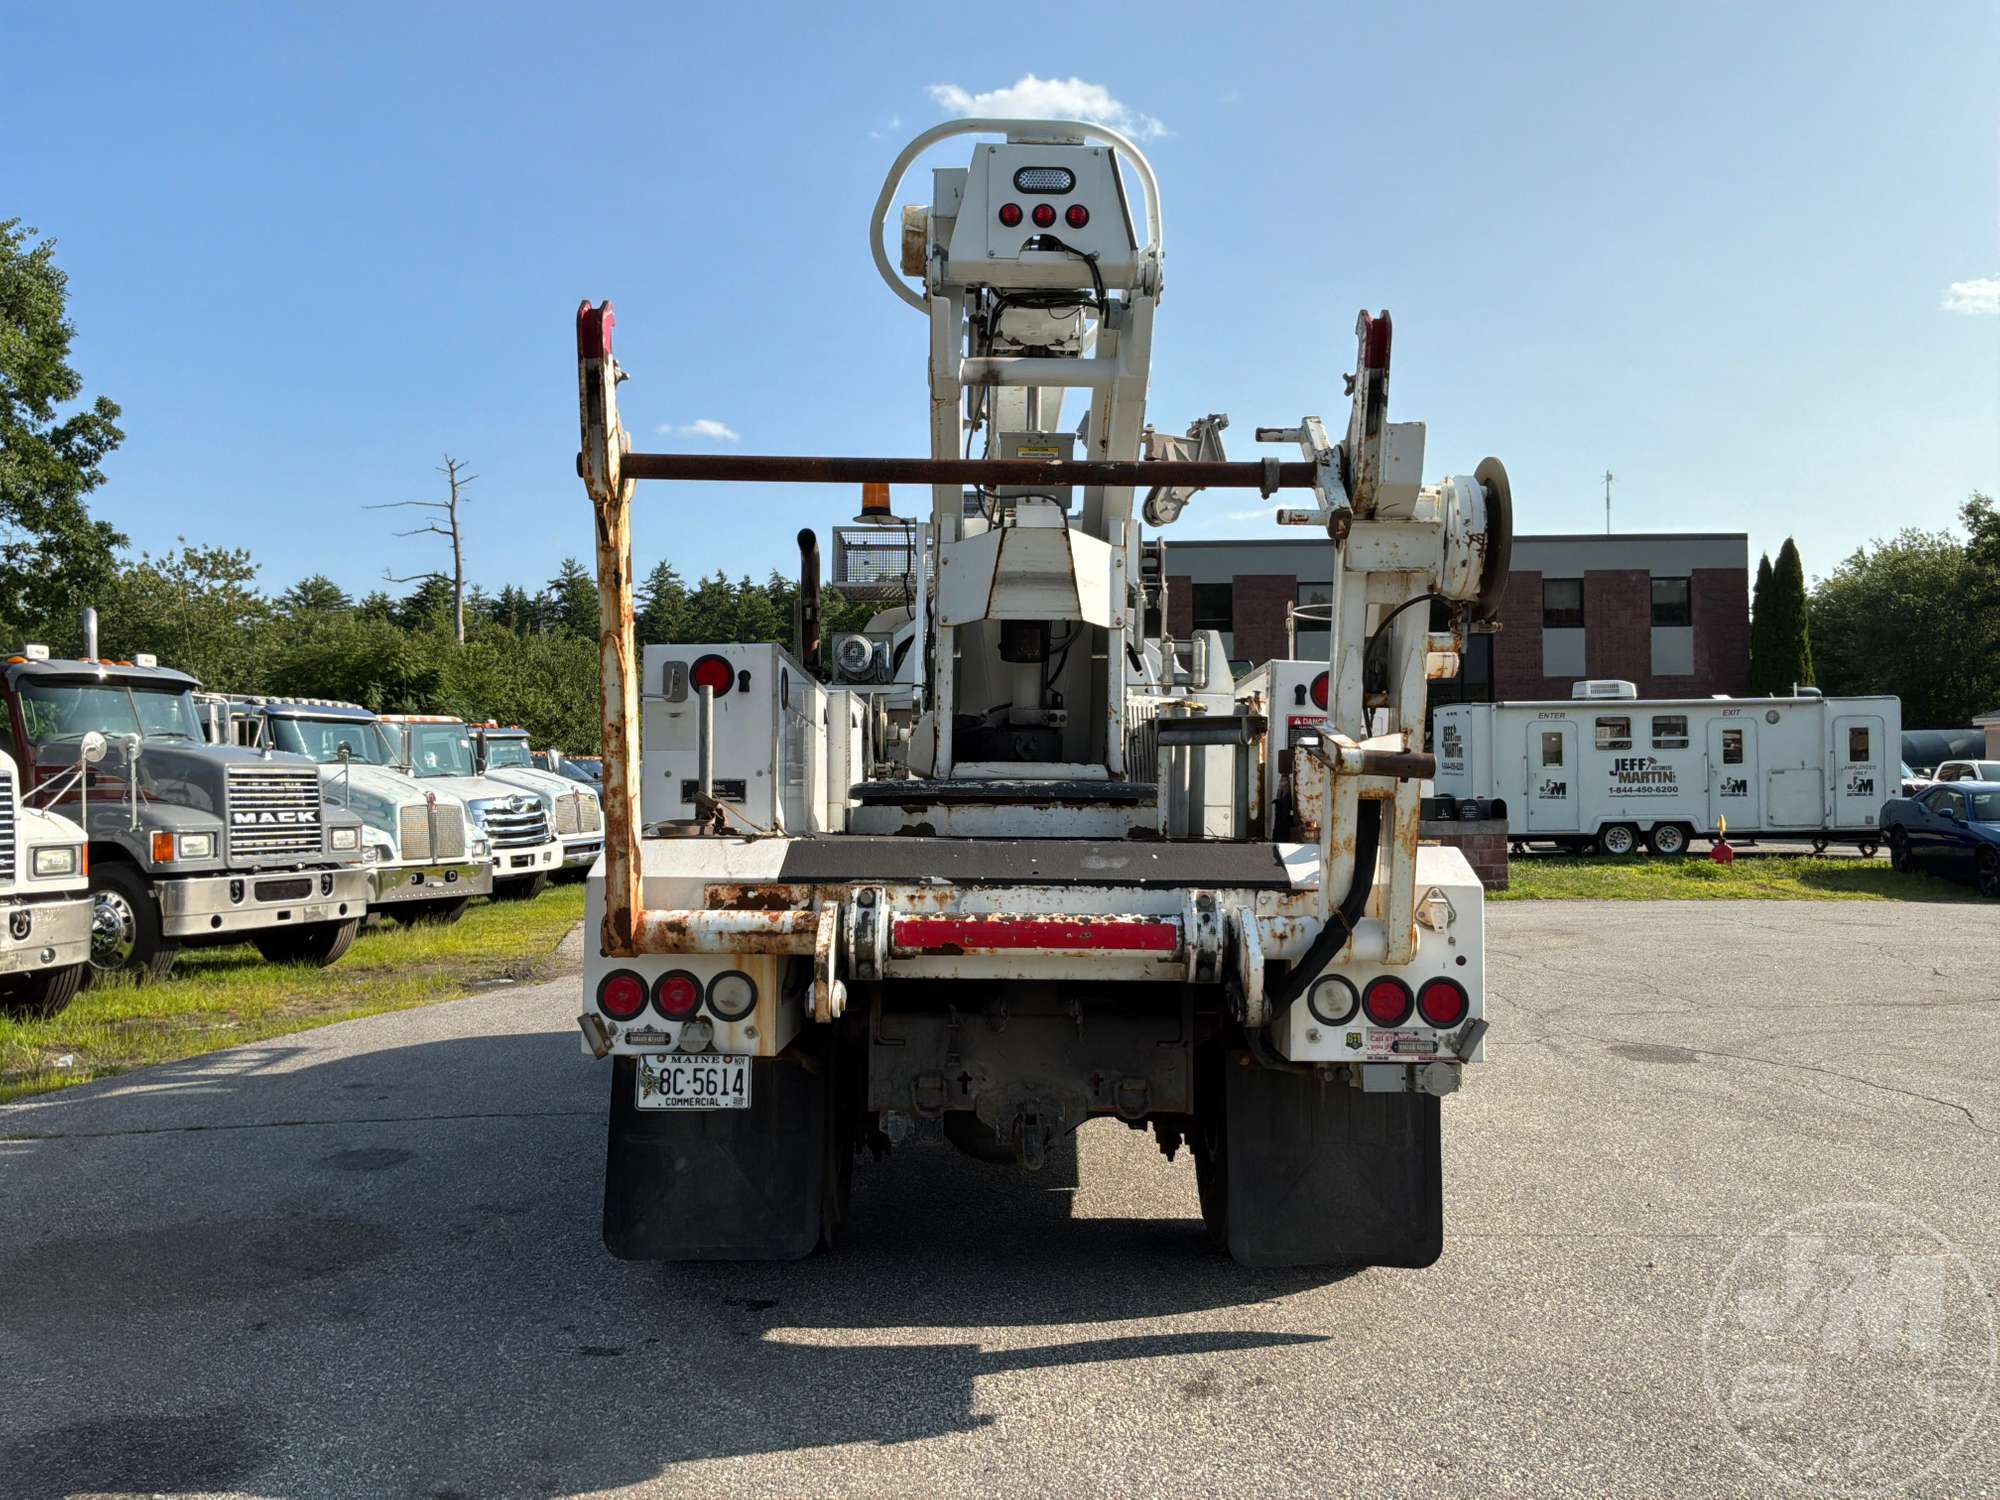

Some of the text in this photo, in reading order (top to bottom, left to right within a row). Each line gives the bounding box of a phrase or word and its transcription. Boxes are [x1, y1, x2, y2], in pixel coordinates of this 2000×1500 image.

[1538, 712, 1566, 720] ENTER
[1722, 709, 1741, 717] EXIT
[1609, 758, 1646, 776] JEFF
[1618, 771, 1673, 784] MARTIN
[1608, 786, 1679, 794] 1-844-450-6200
[233, 811, 317, 824] MACK
[671, 1056, 720, 1064] MAINE
[665, 1097, 721, 1107] COMMERCIAL
